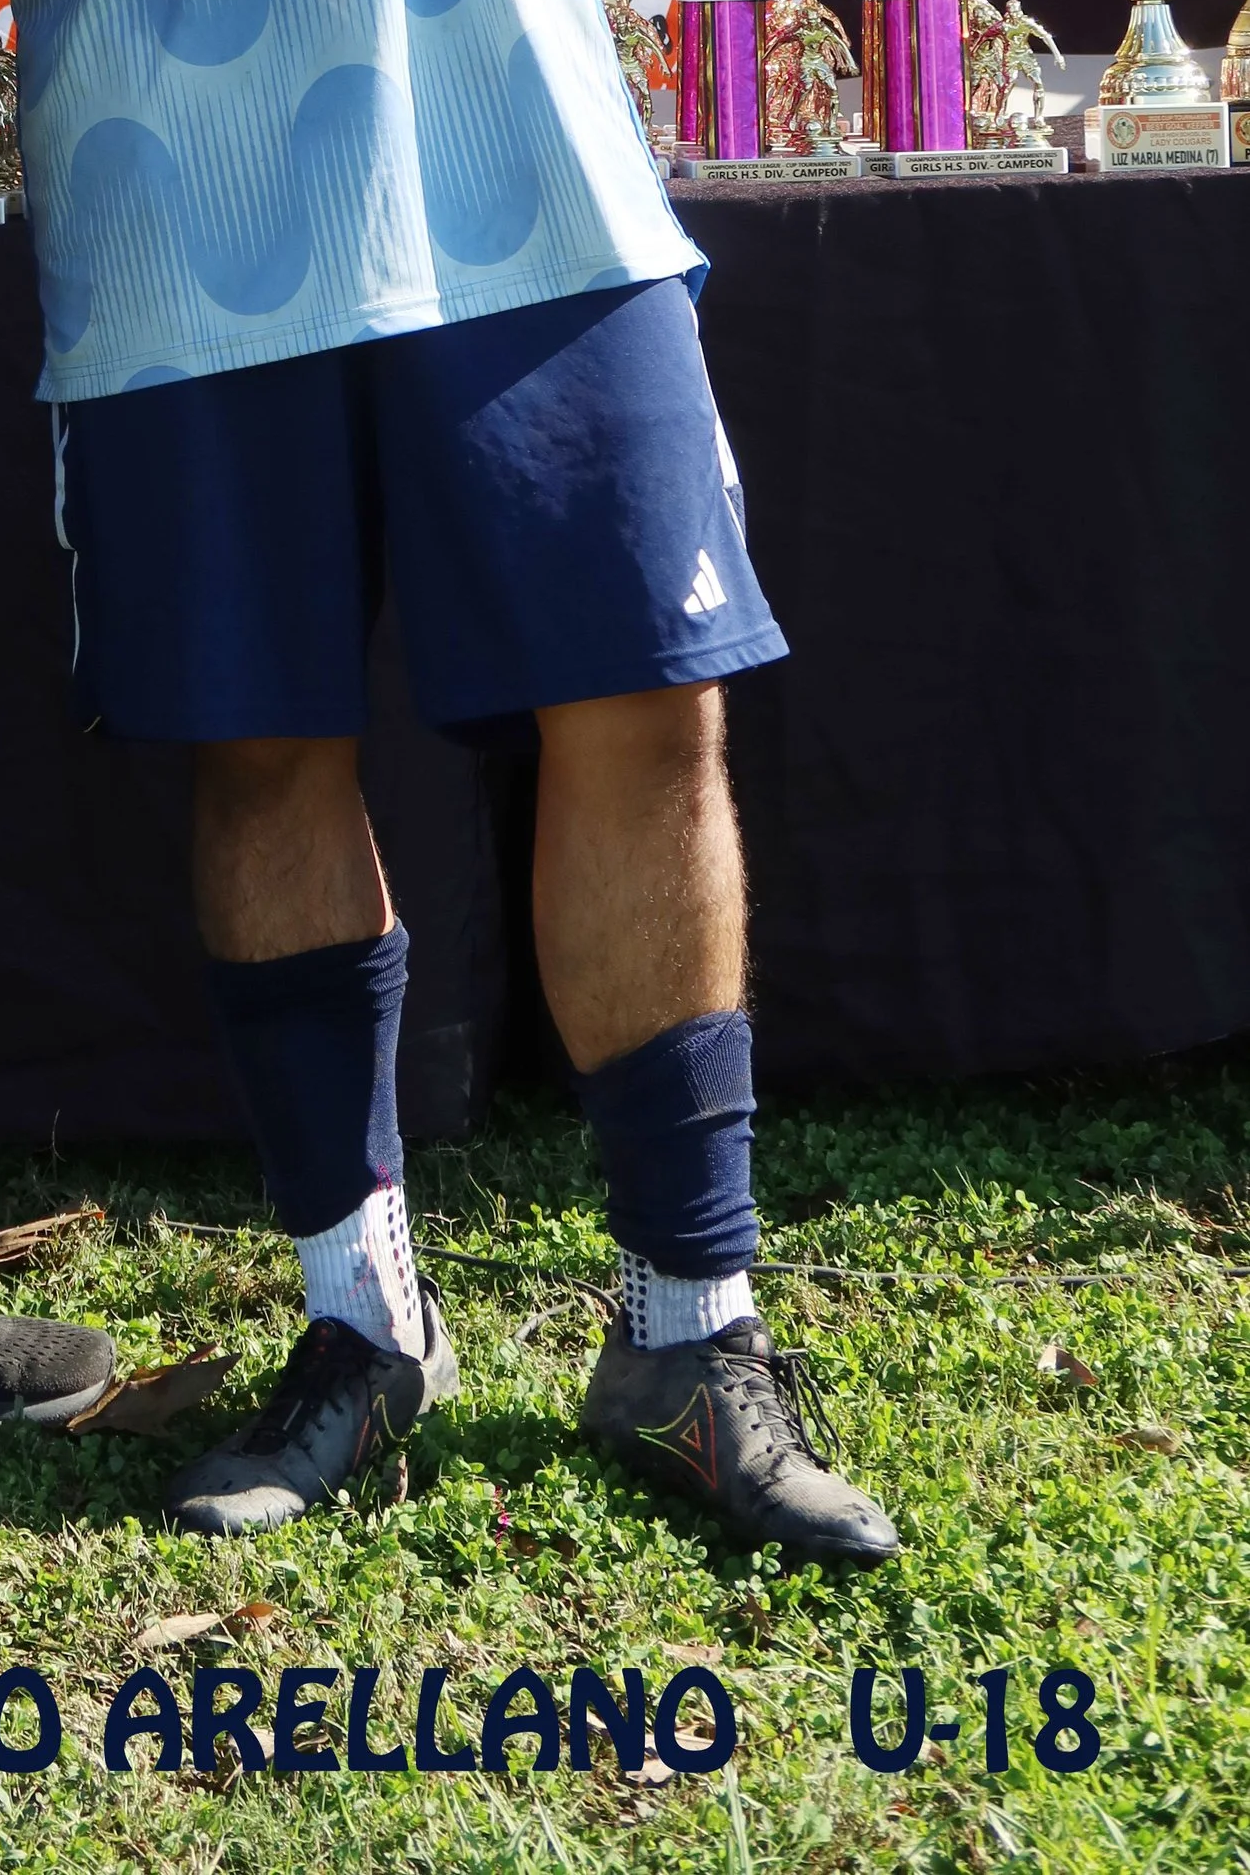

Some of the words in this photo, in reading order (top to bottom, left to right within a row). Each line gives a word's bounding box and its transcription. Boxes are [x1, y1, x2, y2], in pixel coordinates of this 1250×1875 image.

[1150, 138, 1172, 147] LADY
[1172, 137, 1212, 146] COUGARS
[1112, 152, 1128, 166] LUZ
[1132, 151, 1163, 165] MARIA
[1166, 150, 1203, 165] MEDINA
[1206, 149, 1219, 165] (7)
[911, 162, 942, 173] GIRLS
[945, 162, 965, 172] H.S.
[997, 159, 1053, 170] CAMPEON
[707, 171, 738, 180] GIRLS
[741, 171, 761, 180] H.S.
[792, 168, 848, 178] CAMPEON
